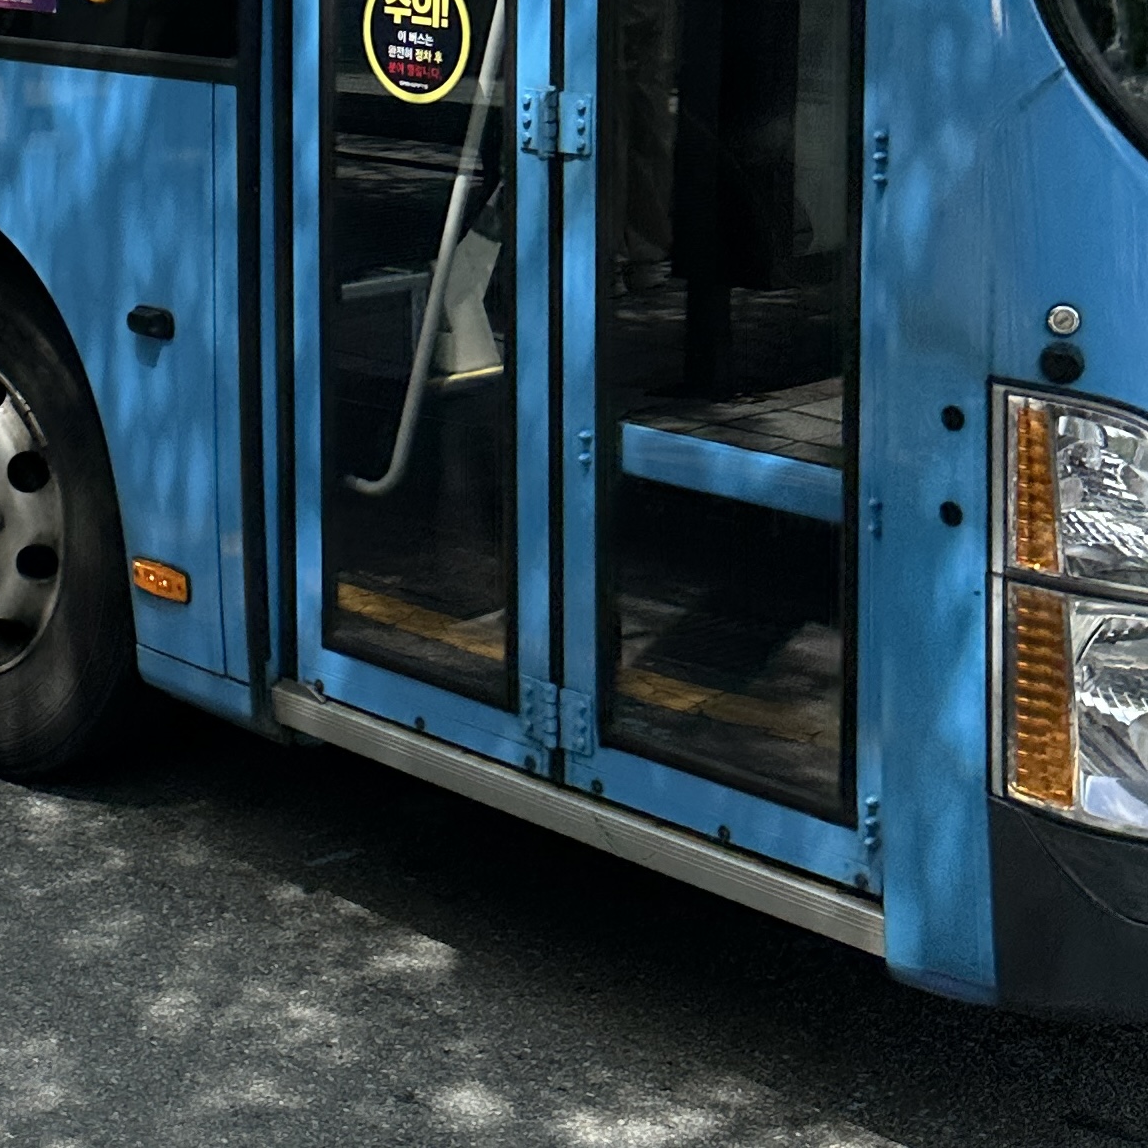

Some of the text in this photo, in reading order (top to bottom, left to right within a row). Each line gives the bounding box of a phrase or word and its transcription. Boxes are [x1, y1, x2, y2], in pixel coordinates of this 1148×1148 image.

[397, 30, 434, 46] 이 버스는
[415, 48, 432, 63] 정차
[434, 51, 443, 64] 후
